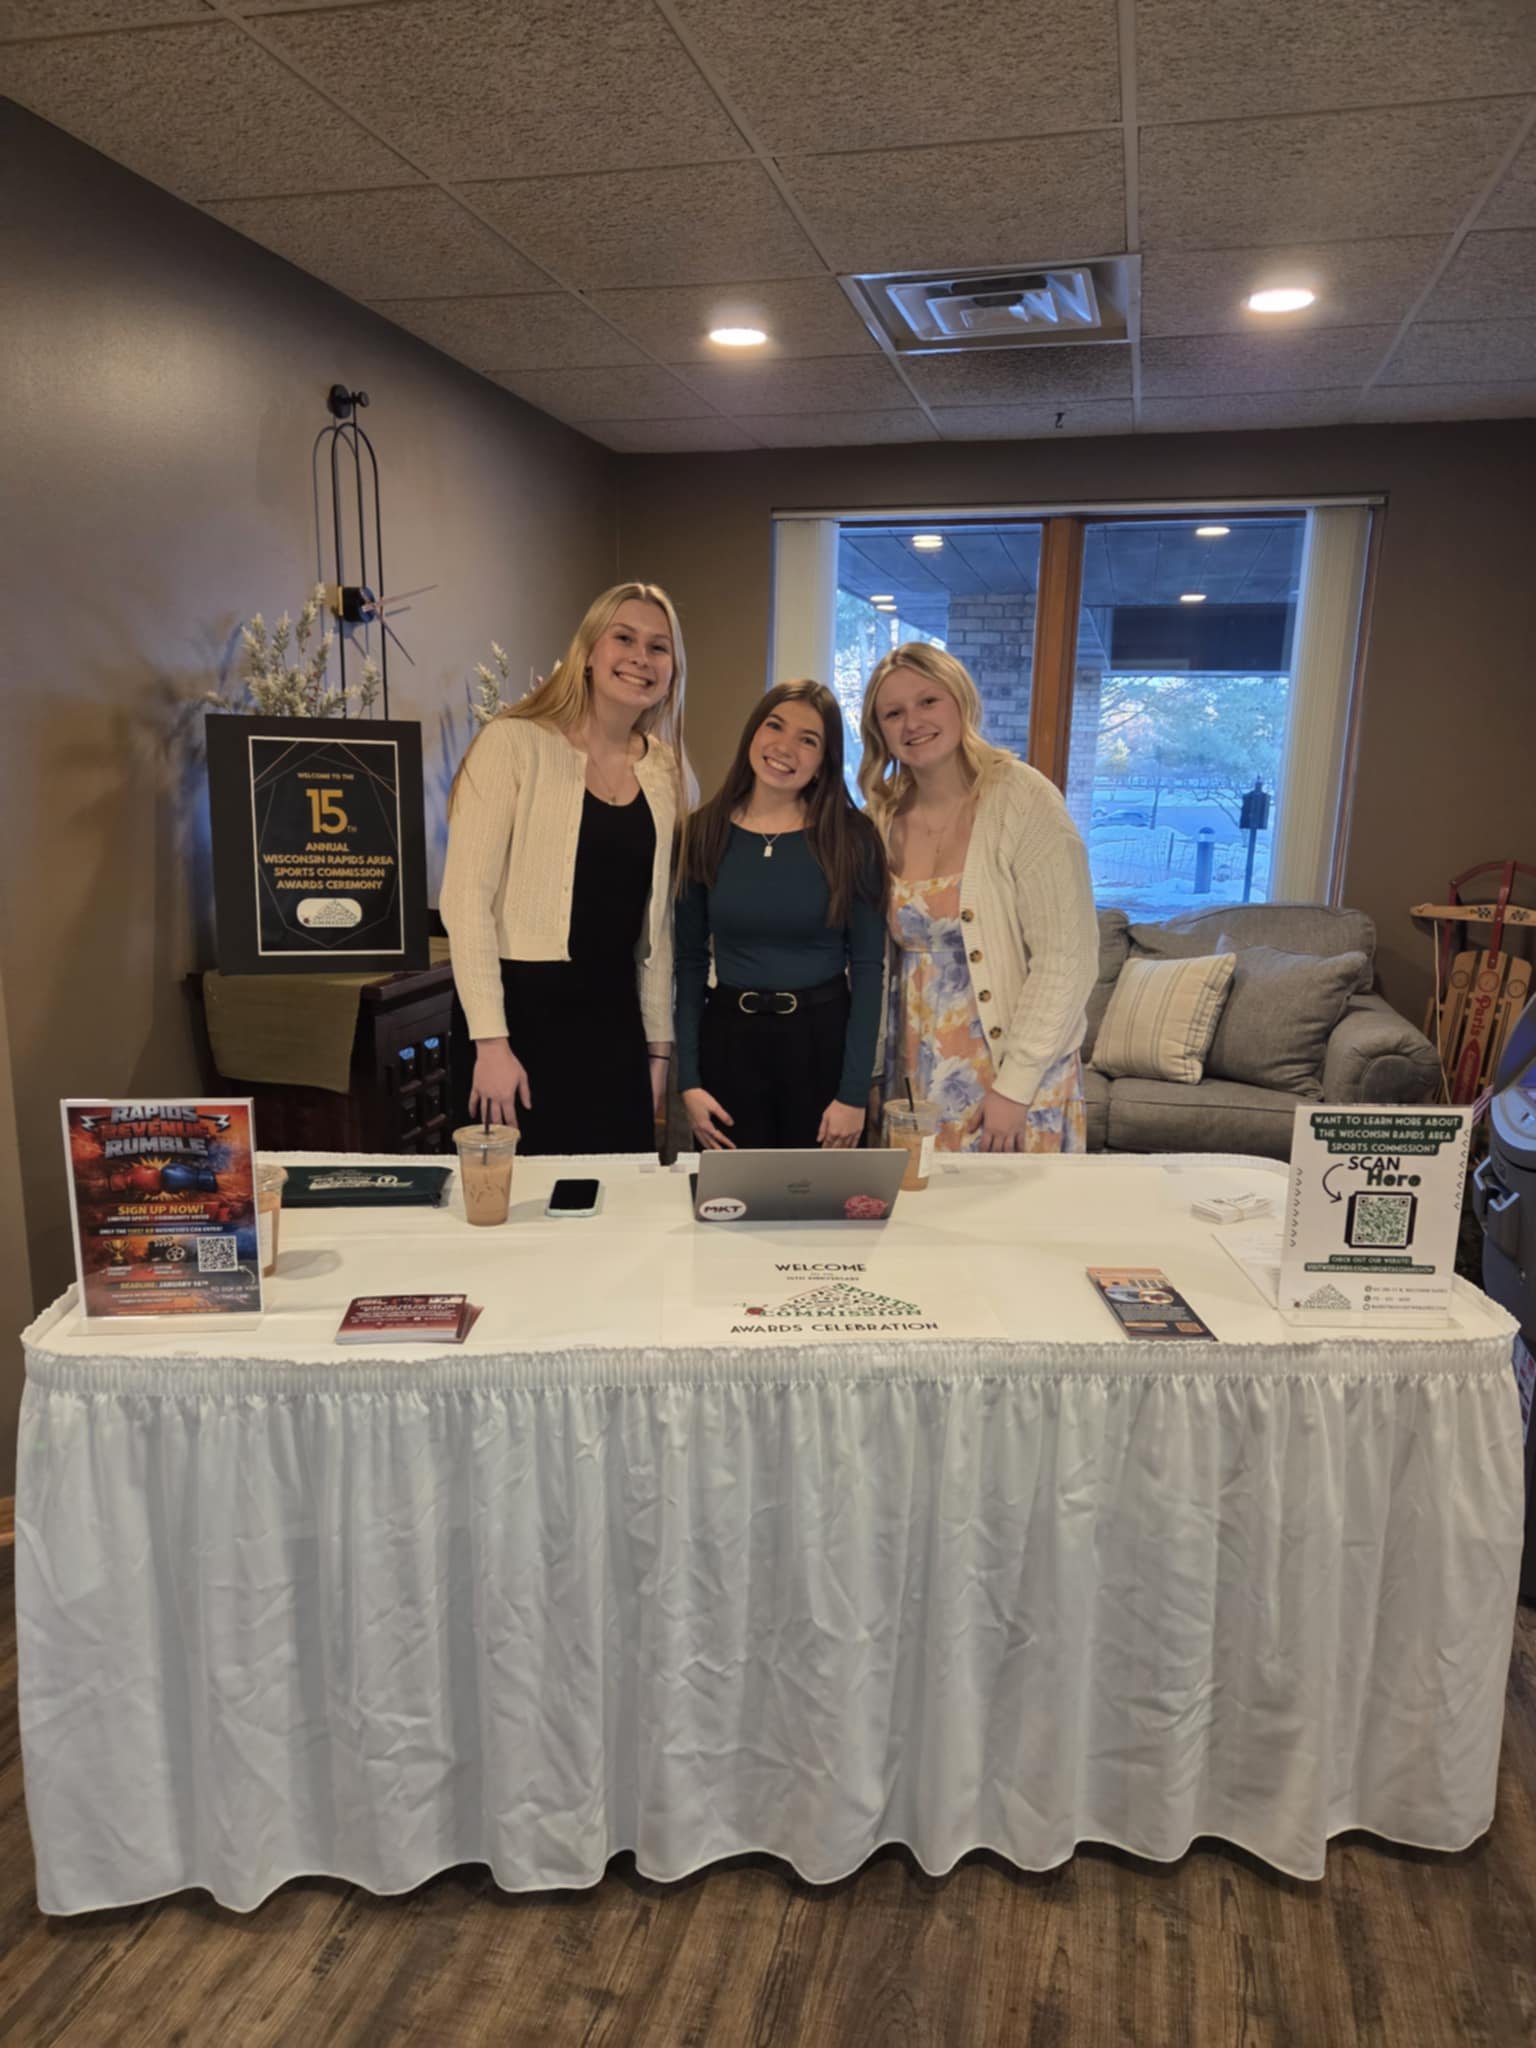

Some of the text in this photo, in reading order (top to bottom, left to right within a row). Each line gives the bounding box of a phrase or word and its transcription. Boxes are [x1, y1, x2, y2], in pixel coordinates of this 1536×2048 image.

[297, 772, 330, 780] WELCOME
[342, 773, 354, 781] THE
[305, 842, 350, 852] ANNUAL
[263, 854, 394, 865] WISCONSIN RAPIDS AREA
[274, 867, 385, 878] SPORTS COMMISSION
[276, 880, 383, 890] AWARDS CEREMONY
[111, 1106, 198, 1123] RAPIDS
[1314, 1116, 1460, 1127] WANT TO LEARN MORE ABOUT
[1319, 1129, 1451, 1140] THE WISCONSIN RAPIDS AREA
[105, 1137, 209, 1158] RUMBLE
[1331, 1143, 1436, 1153] SPORTS COMMISSION?
[1348, 1156, 1402, 1170] SCAN
[1366, 1168, 1421, 1187] Here
[118, 1204, 205, 1215] SIGN UP NOW!
[703, 1204, 744, 1214] MKT
[775, 1263, 867, 1272] WELCOME
[832, 1283, 920, 1311] SPORTS
[761, 1309, 922, 1317] COMMISSION
[730, 1322, 939, 1334] AWARDS CELEBRATION
